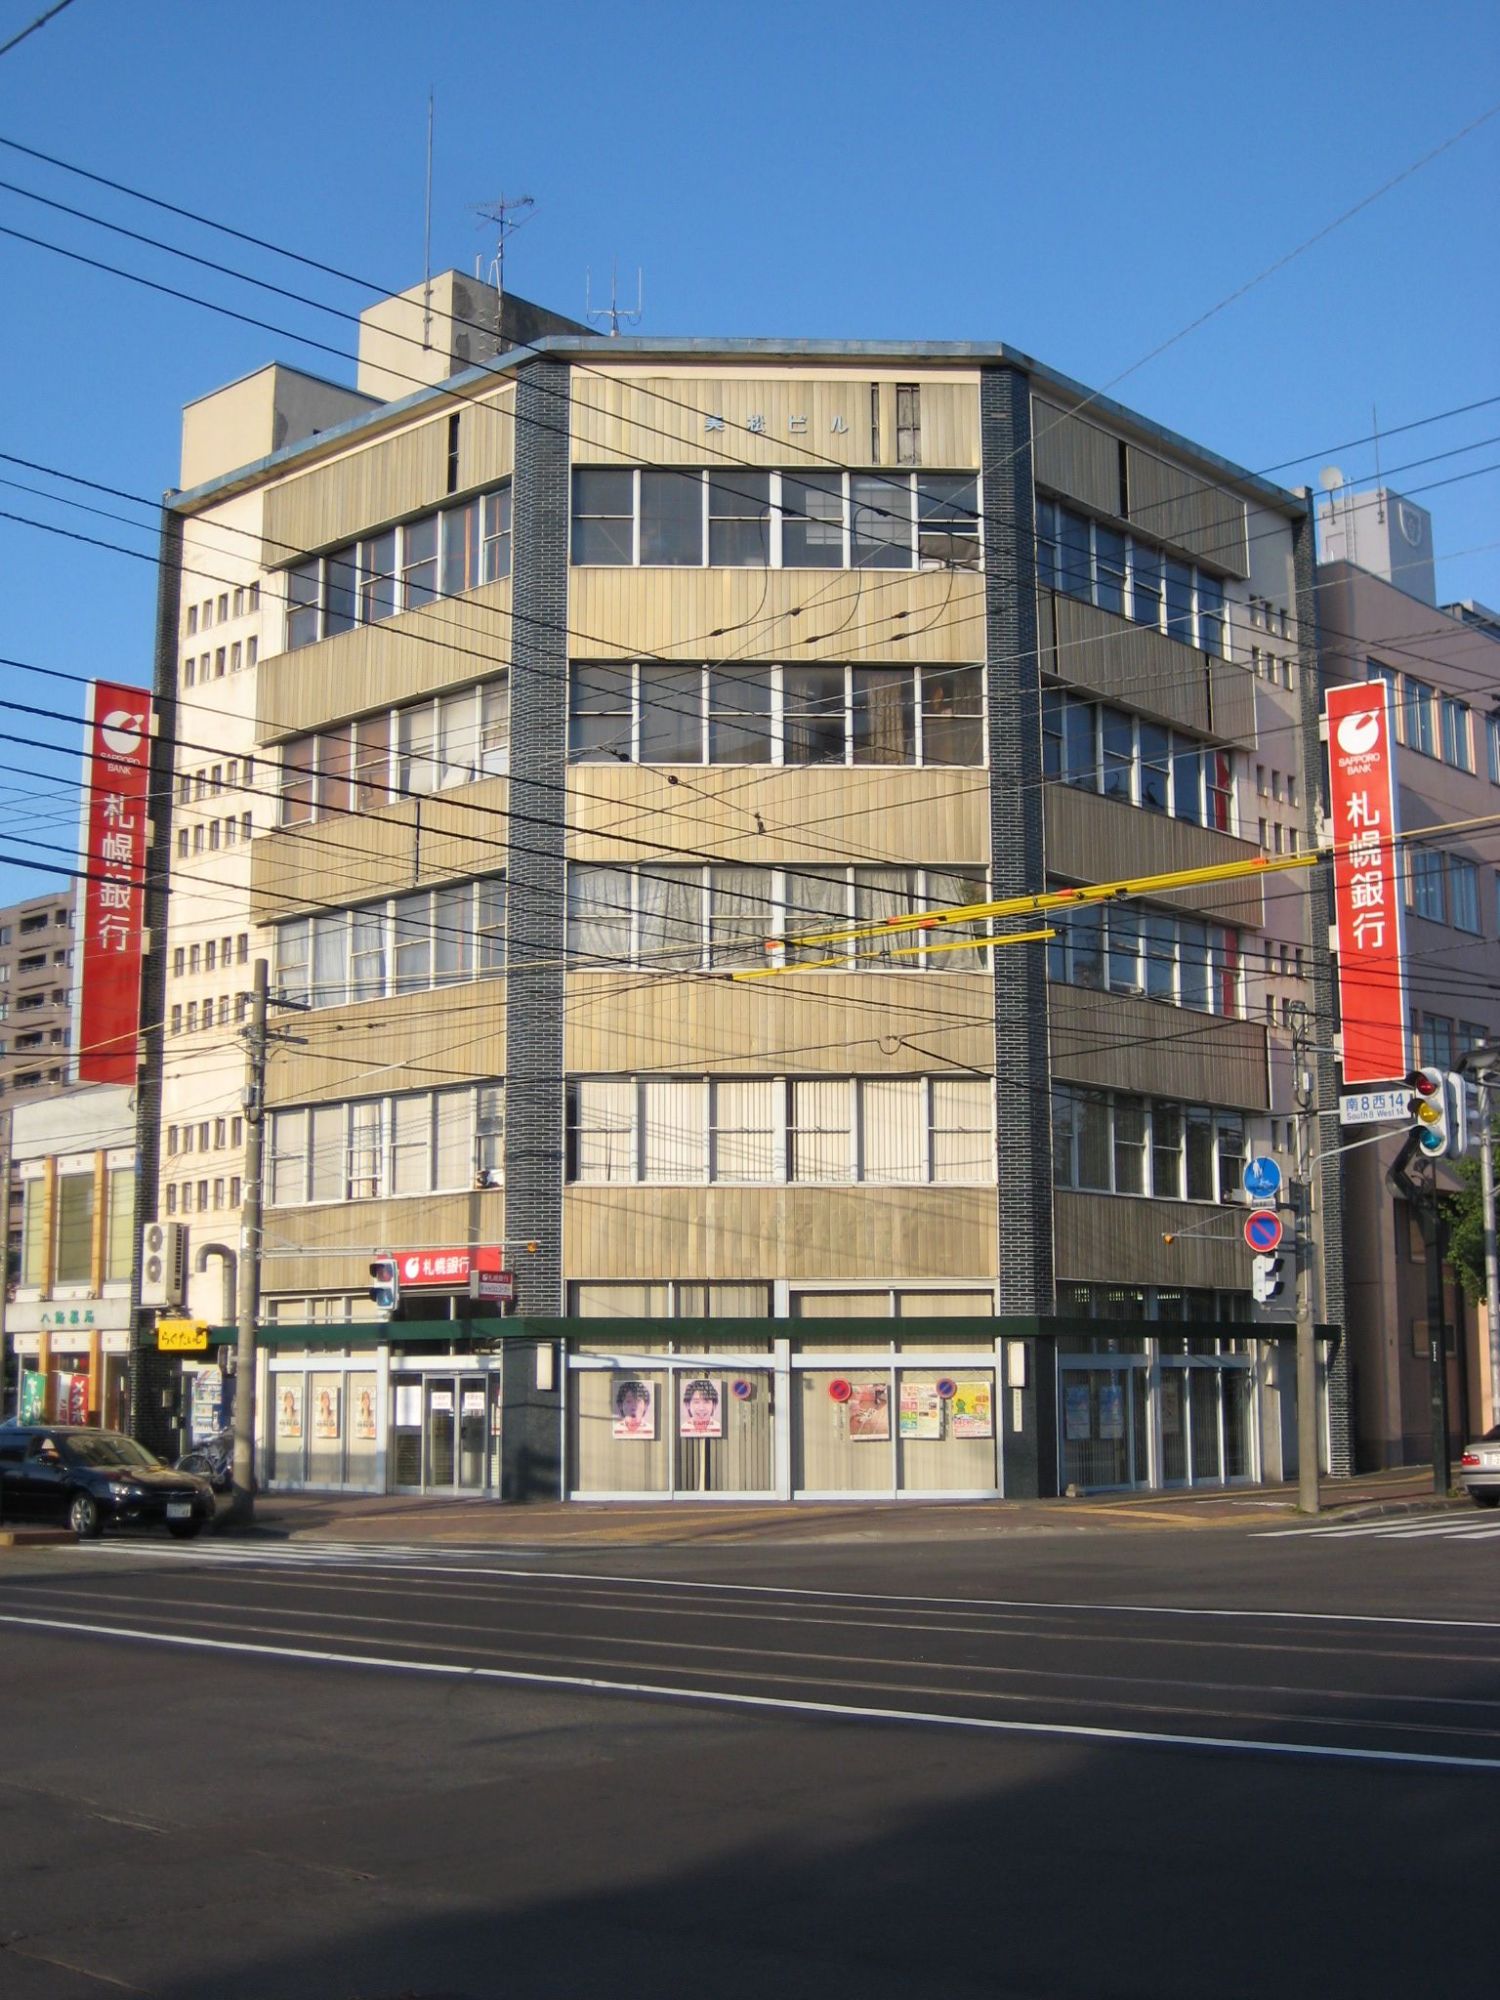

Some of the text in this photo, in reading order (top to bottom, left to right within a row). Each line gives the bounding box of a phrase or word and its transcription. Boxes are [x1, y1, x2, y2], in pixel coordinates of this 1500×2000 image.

[107, 763, 132, 775] BANK
[1338, 752, 1381, 768] SAPPORO
[1346, 763, 1372, 776] BANK
[98, 792, 135, 951] 札幌銀行
[1346, 790, 1385, 950] 札幌銀行
[423, 1256, 470, 1276] 札幌銀行
